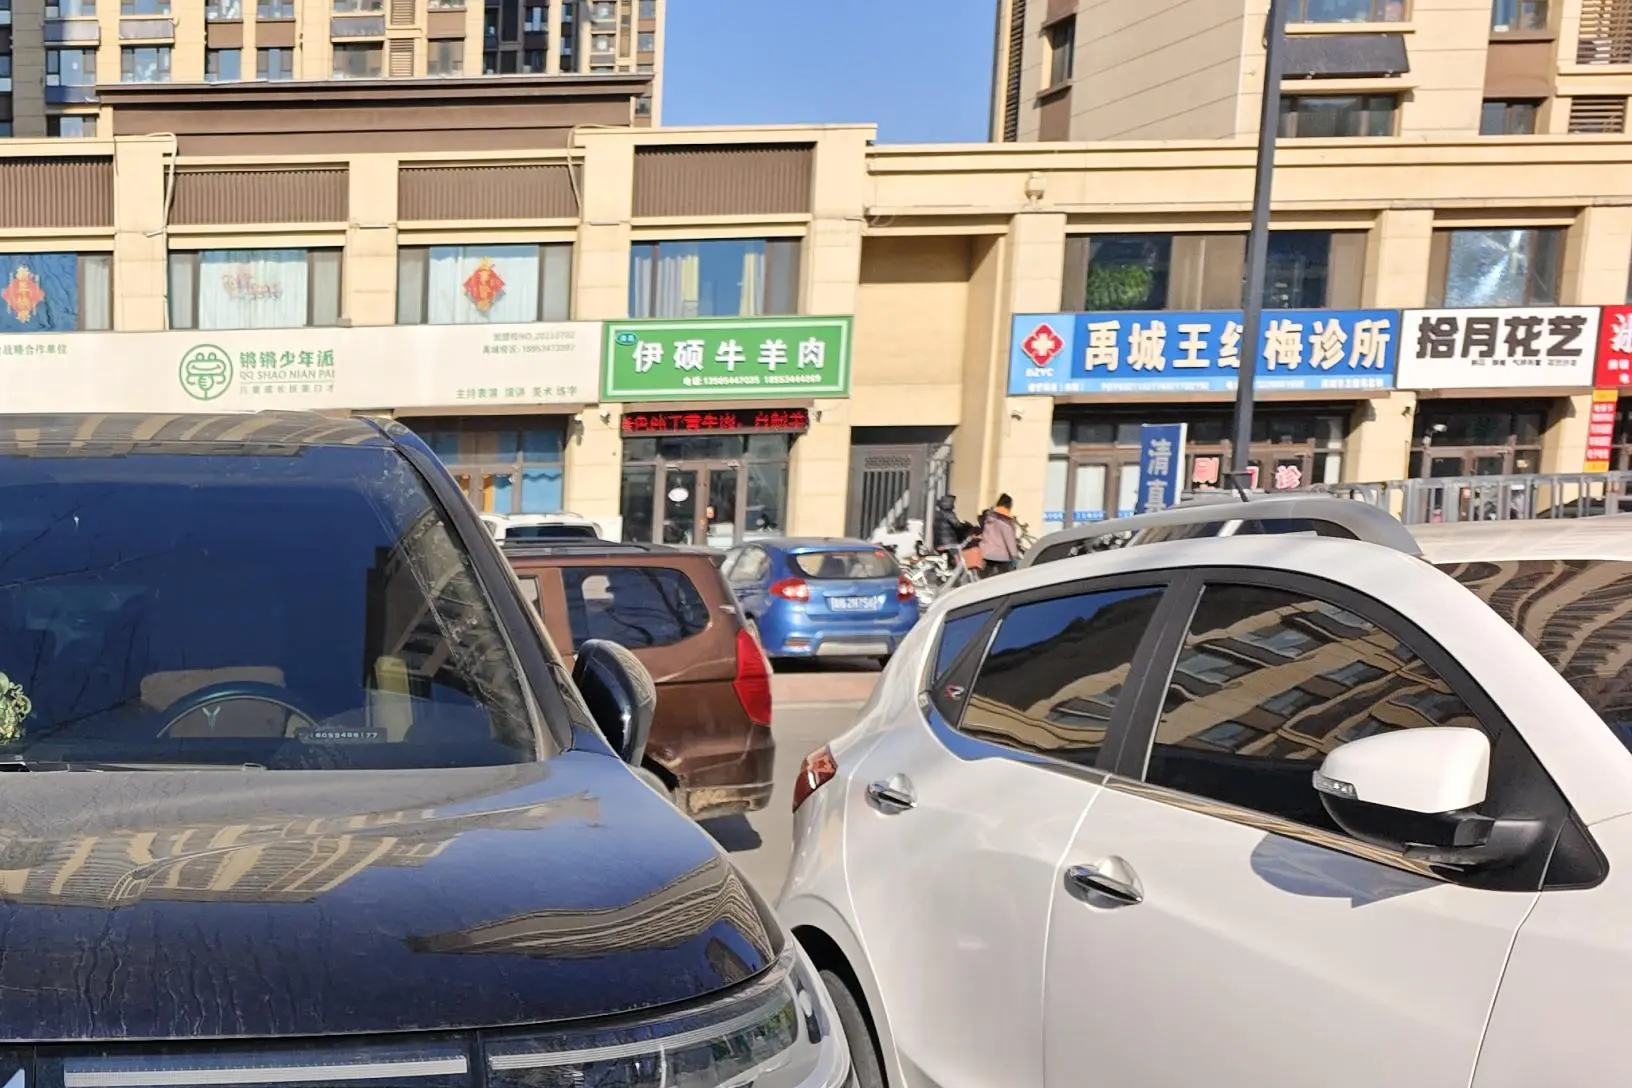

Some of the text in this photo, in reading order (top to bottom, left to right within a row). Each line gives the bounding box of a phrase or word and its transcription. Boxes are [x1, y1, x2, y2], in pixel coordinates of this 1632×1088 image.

[631, 336, 826, 374] 伊硕牛羊肉
[1415, 315, 1588, 359] 拾月花艺
[257, 370, 286, 380] SHAO
[289, 369, 316, 379] NIAN
[318, 369, 335, 379] PAI
